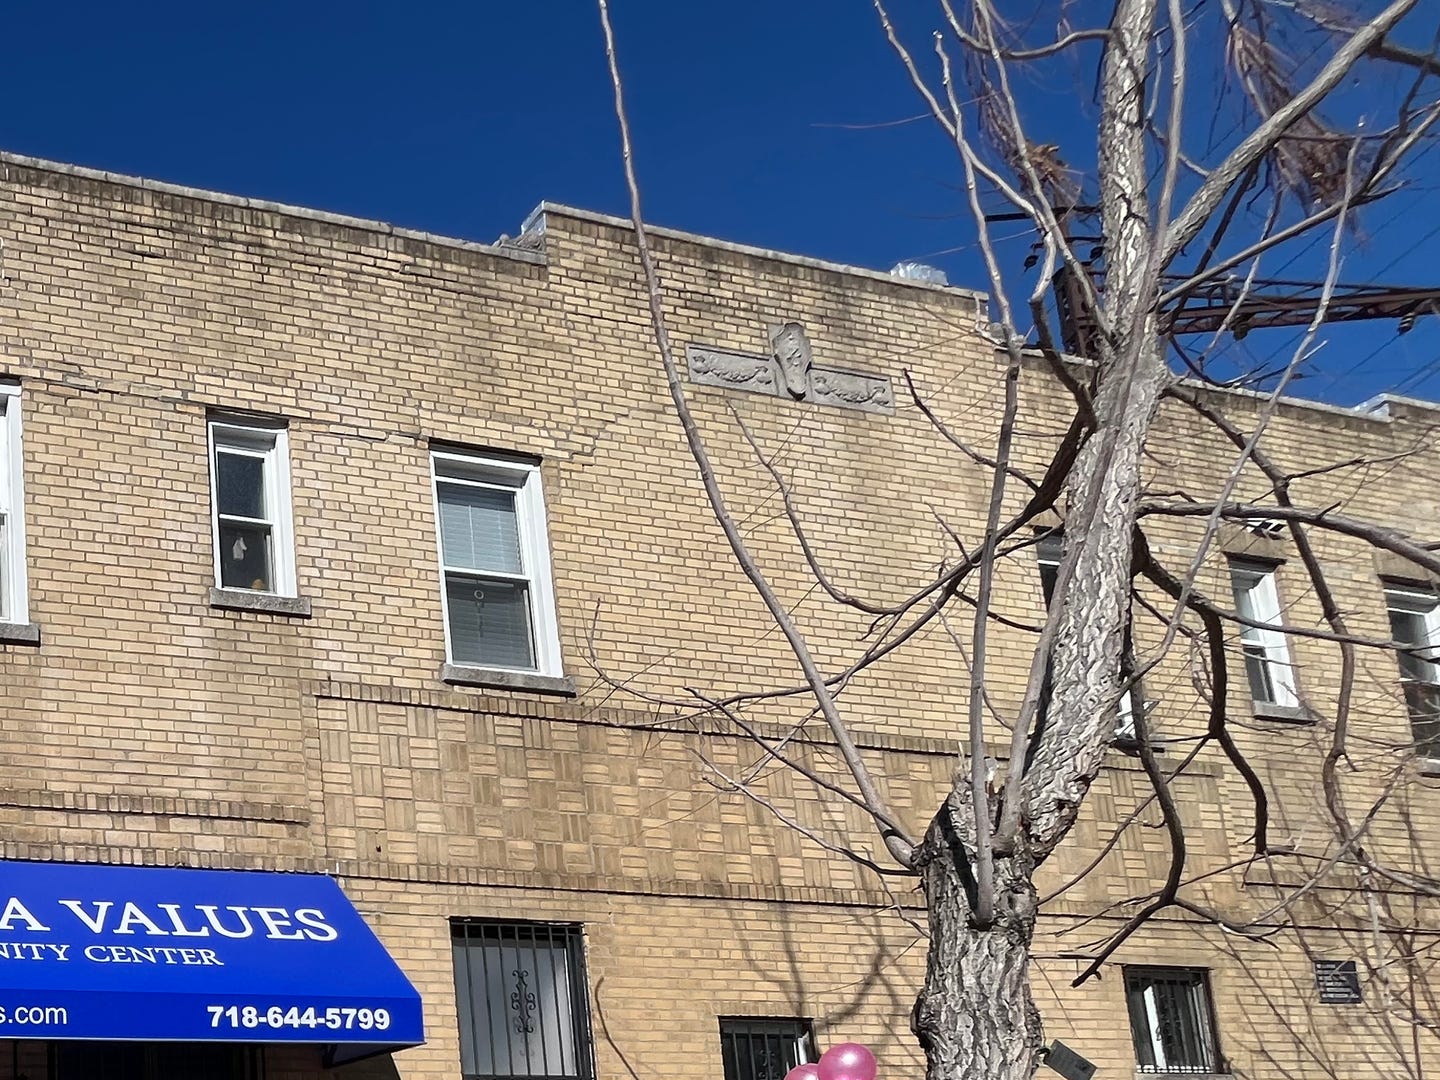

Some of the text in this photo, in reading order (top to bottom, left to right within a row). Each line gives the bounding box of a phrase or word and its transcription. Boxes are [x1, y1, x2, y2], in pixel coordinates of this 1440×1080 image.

[57, 899, 339, 942] VALUES
[83, 945, 225, 966] CENTER
[206, 1005, 391, 1030] 718-644-5799
